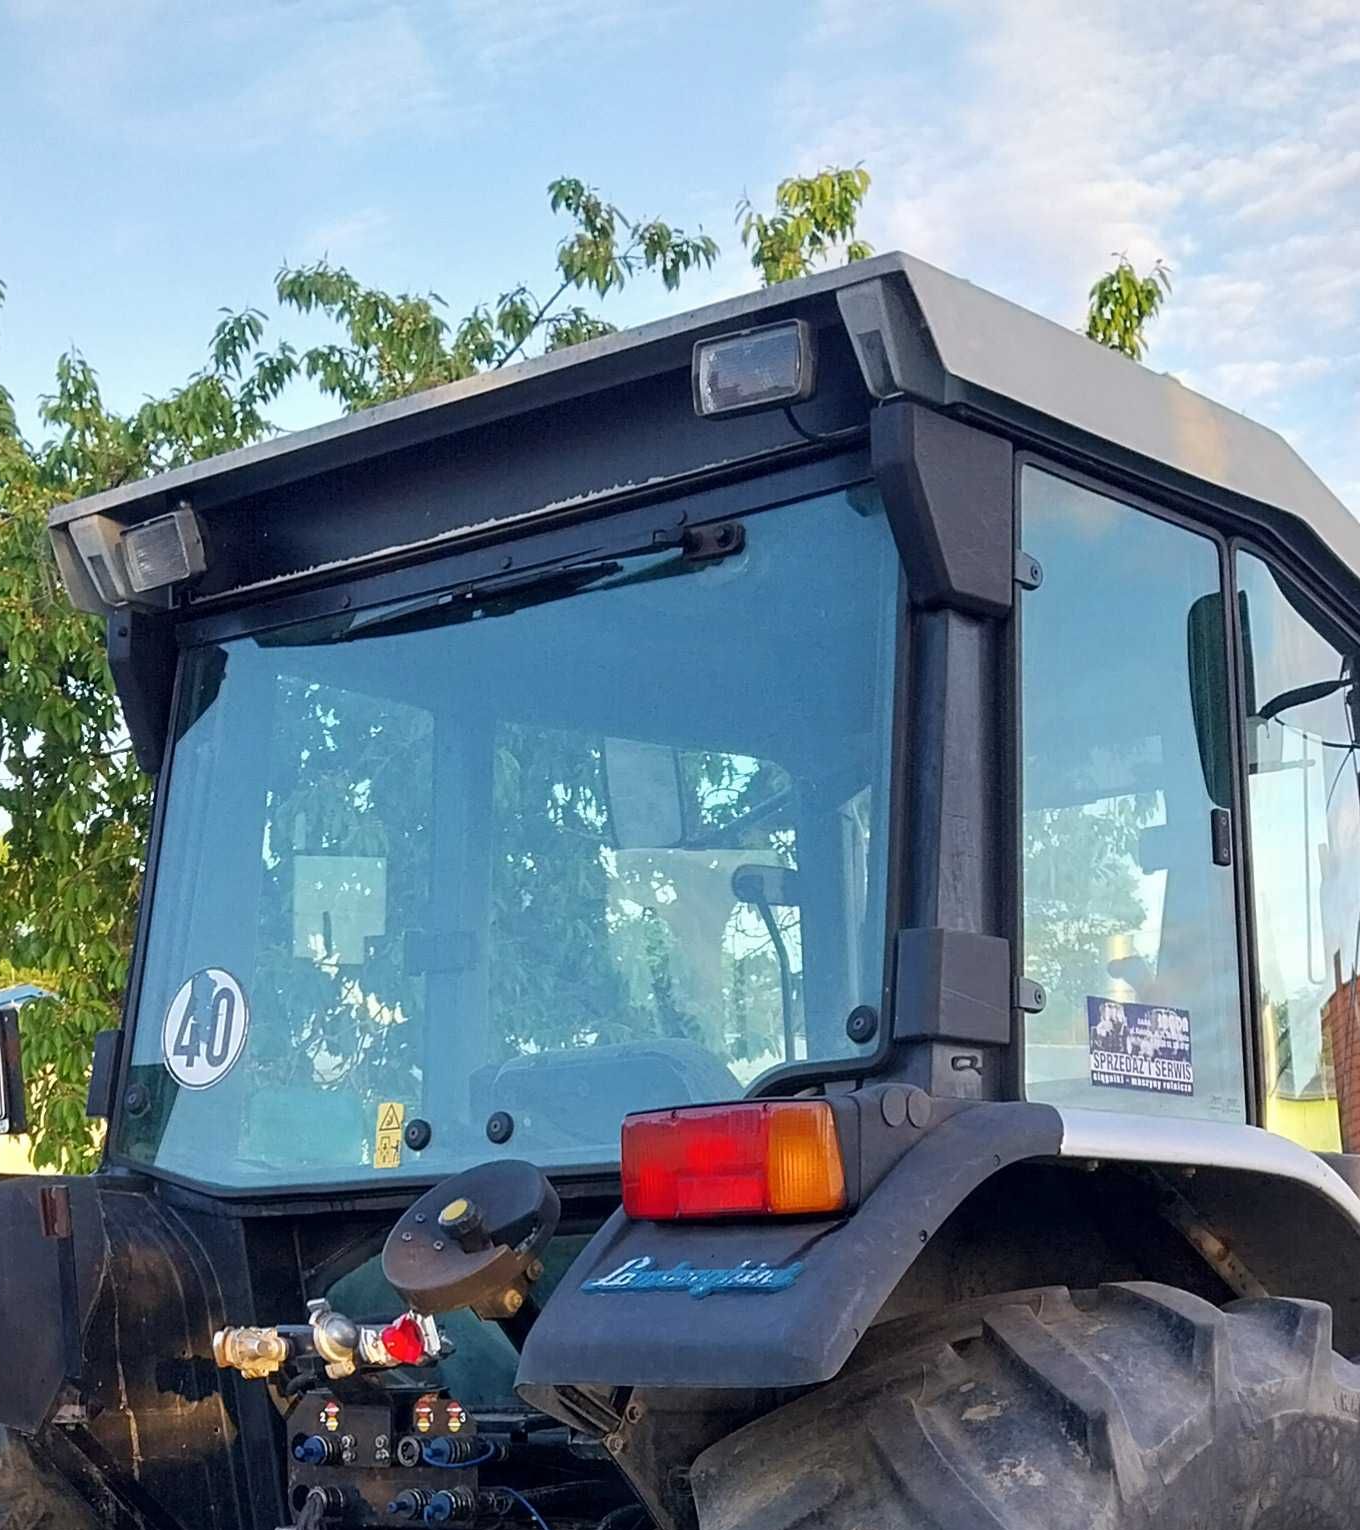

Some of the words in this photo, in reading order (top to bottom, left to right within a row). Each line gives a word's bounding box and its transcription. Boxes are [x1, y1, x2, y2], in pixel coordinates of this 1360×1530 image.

[173, 987, 235, 1067] 40
[1154, 1060, 1192, 1080] SERWIS
[320, 1412, 326, 1422] 2
[460, 1412, 466, 1422] 3
